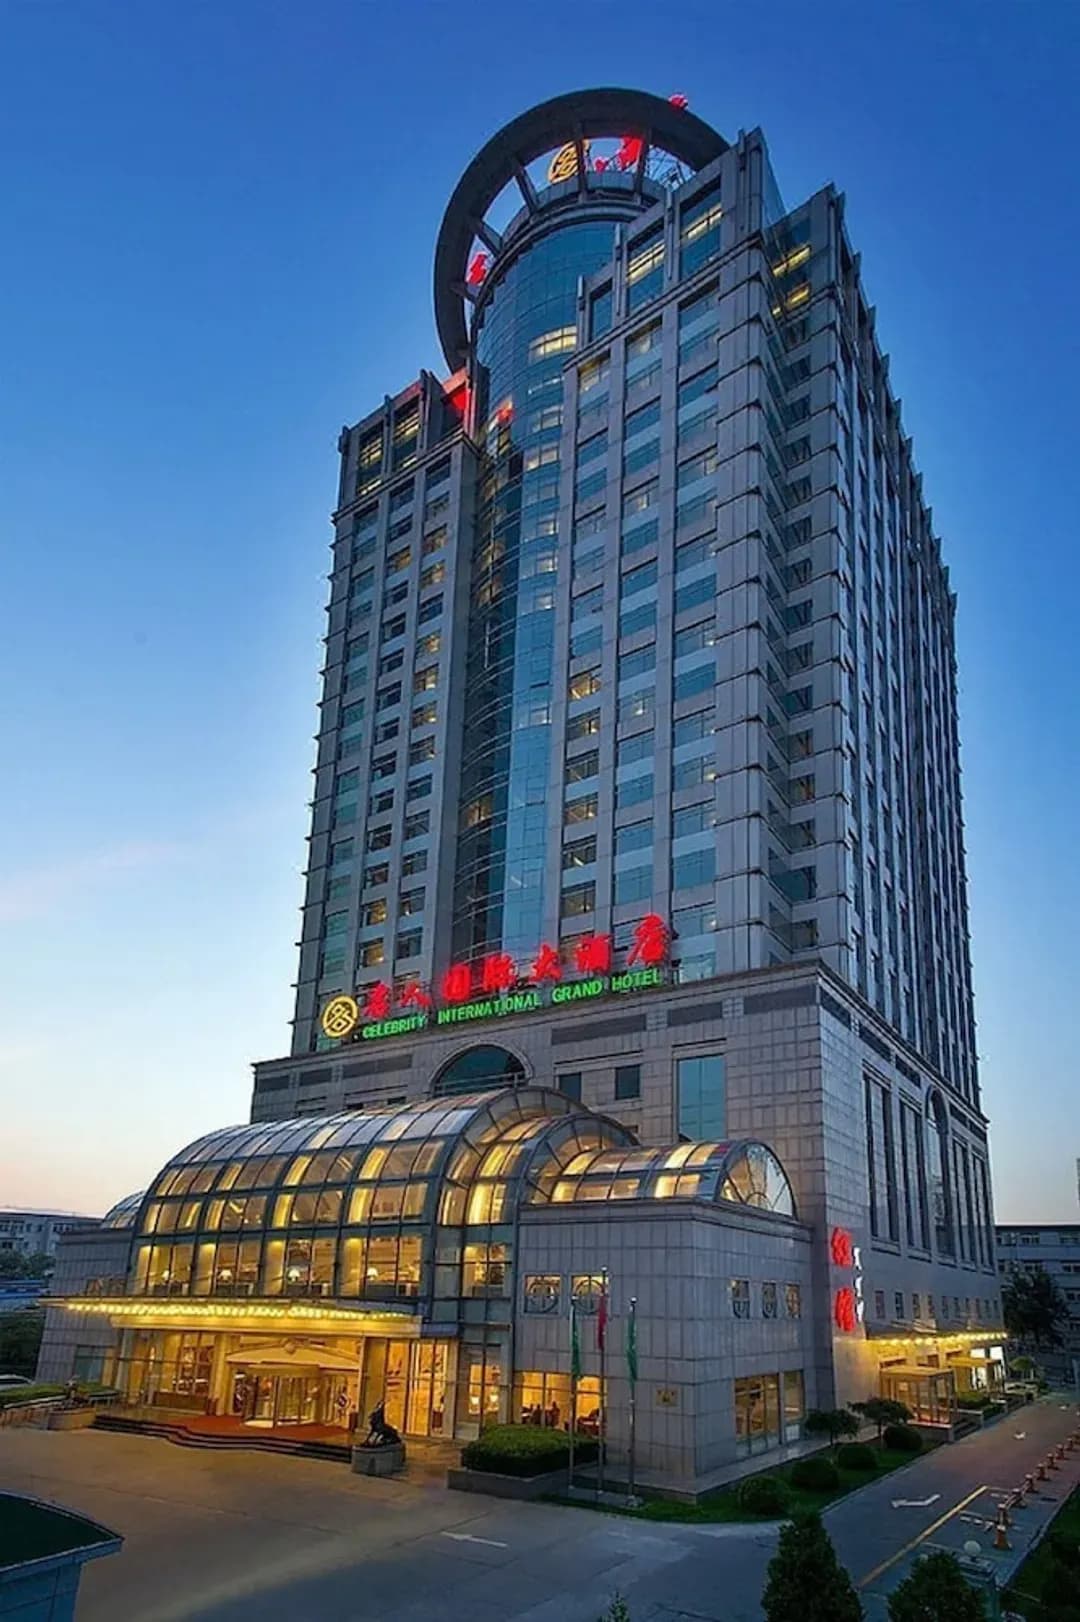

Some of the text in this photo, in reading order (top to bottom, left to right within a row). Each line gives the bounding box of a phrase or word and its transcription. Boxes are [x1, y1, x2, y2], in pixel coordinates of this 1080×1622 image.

[363, 968, 661, 1038] CELEBRITY INTERNATIONAL GRAND HOTEL
